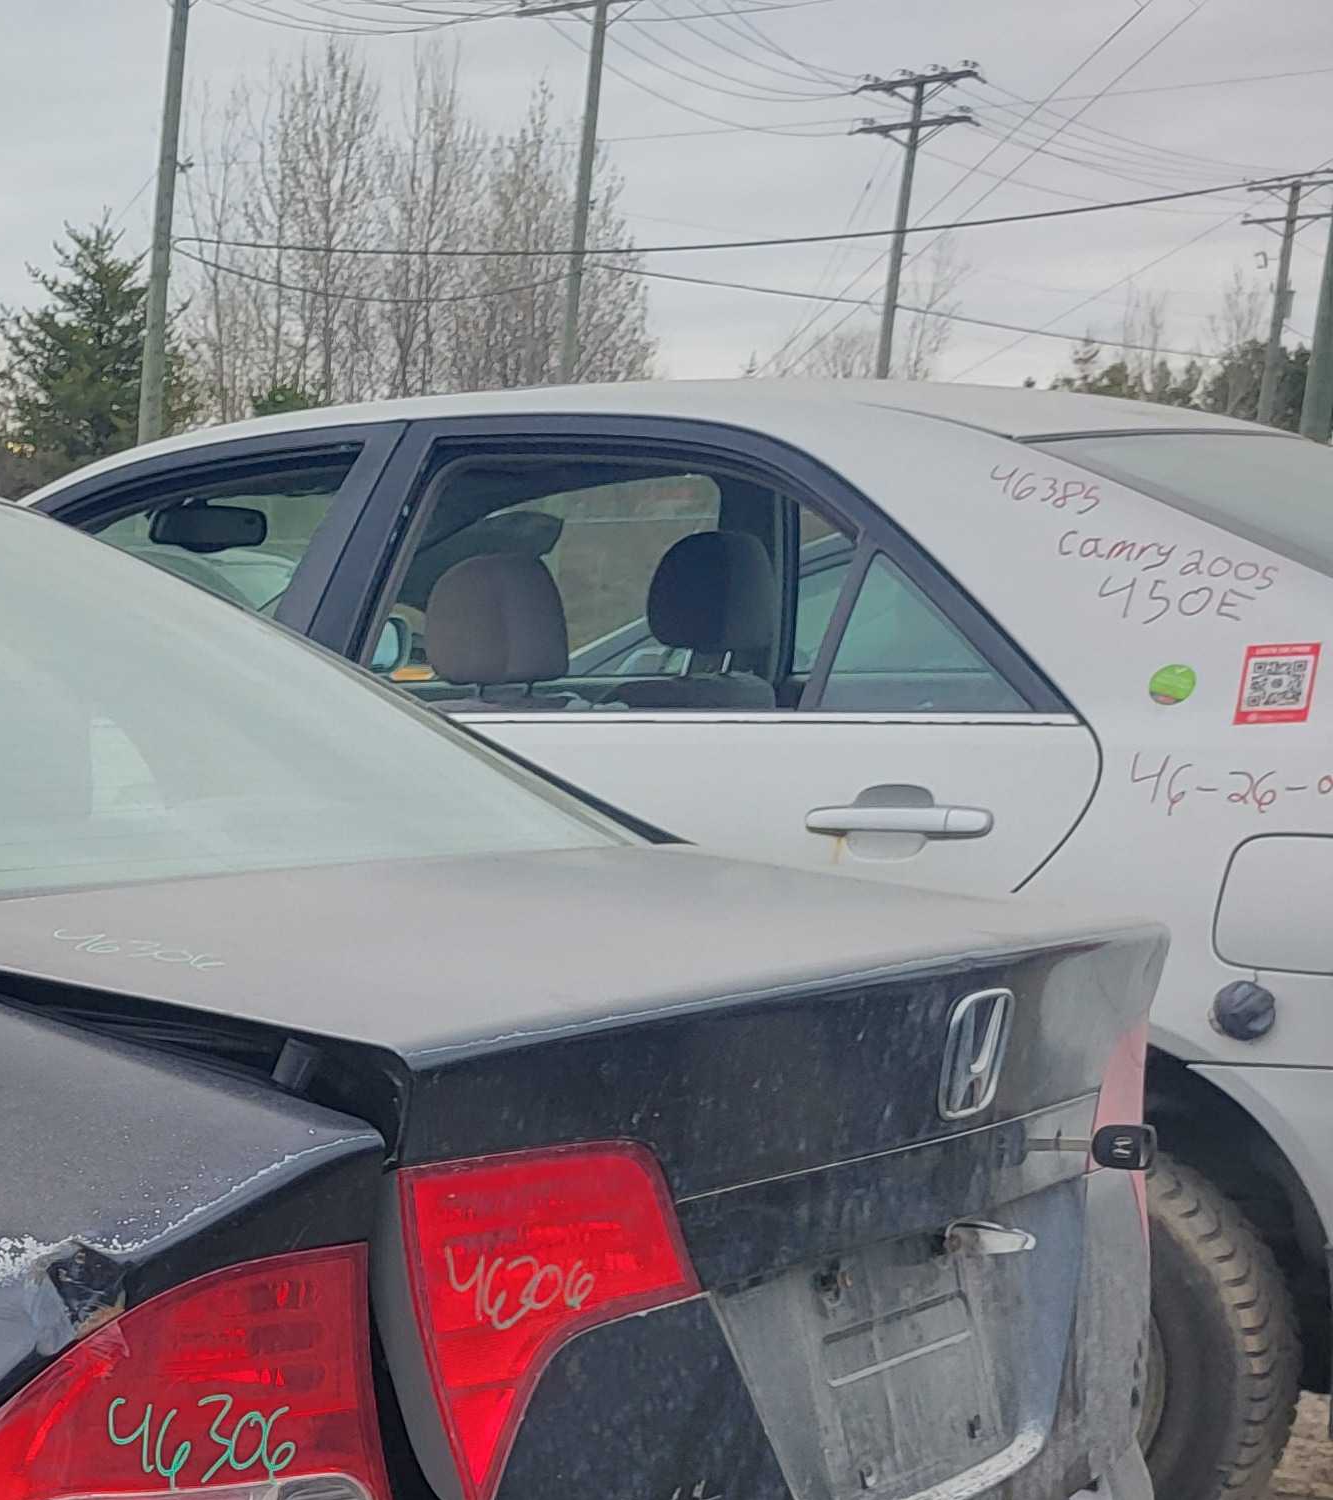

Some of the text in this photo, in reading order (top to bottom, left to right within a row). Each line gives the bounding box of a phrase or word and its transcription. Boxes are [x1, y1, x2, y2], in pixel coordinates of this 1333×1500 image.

[989, 464, 1100, 515] 46385
[1058, 530, 1279, 591] Camry 2005
[1097, 575, 1256, 625] 450E
[108, 1395, 297, 1491] 46306
